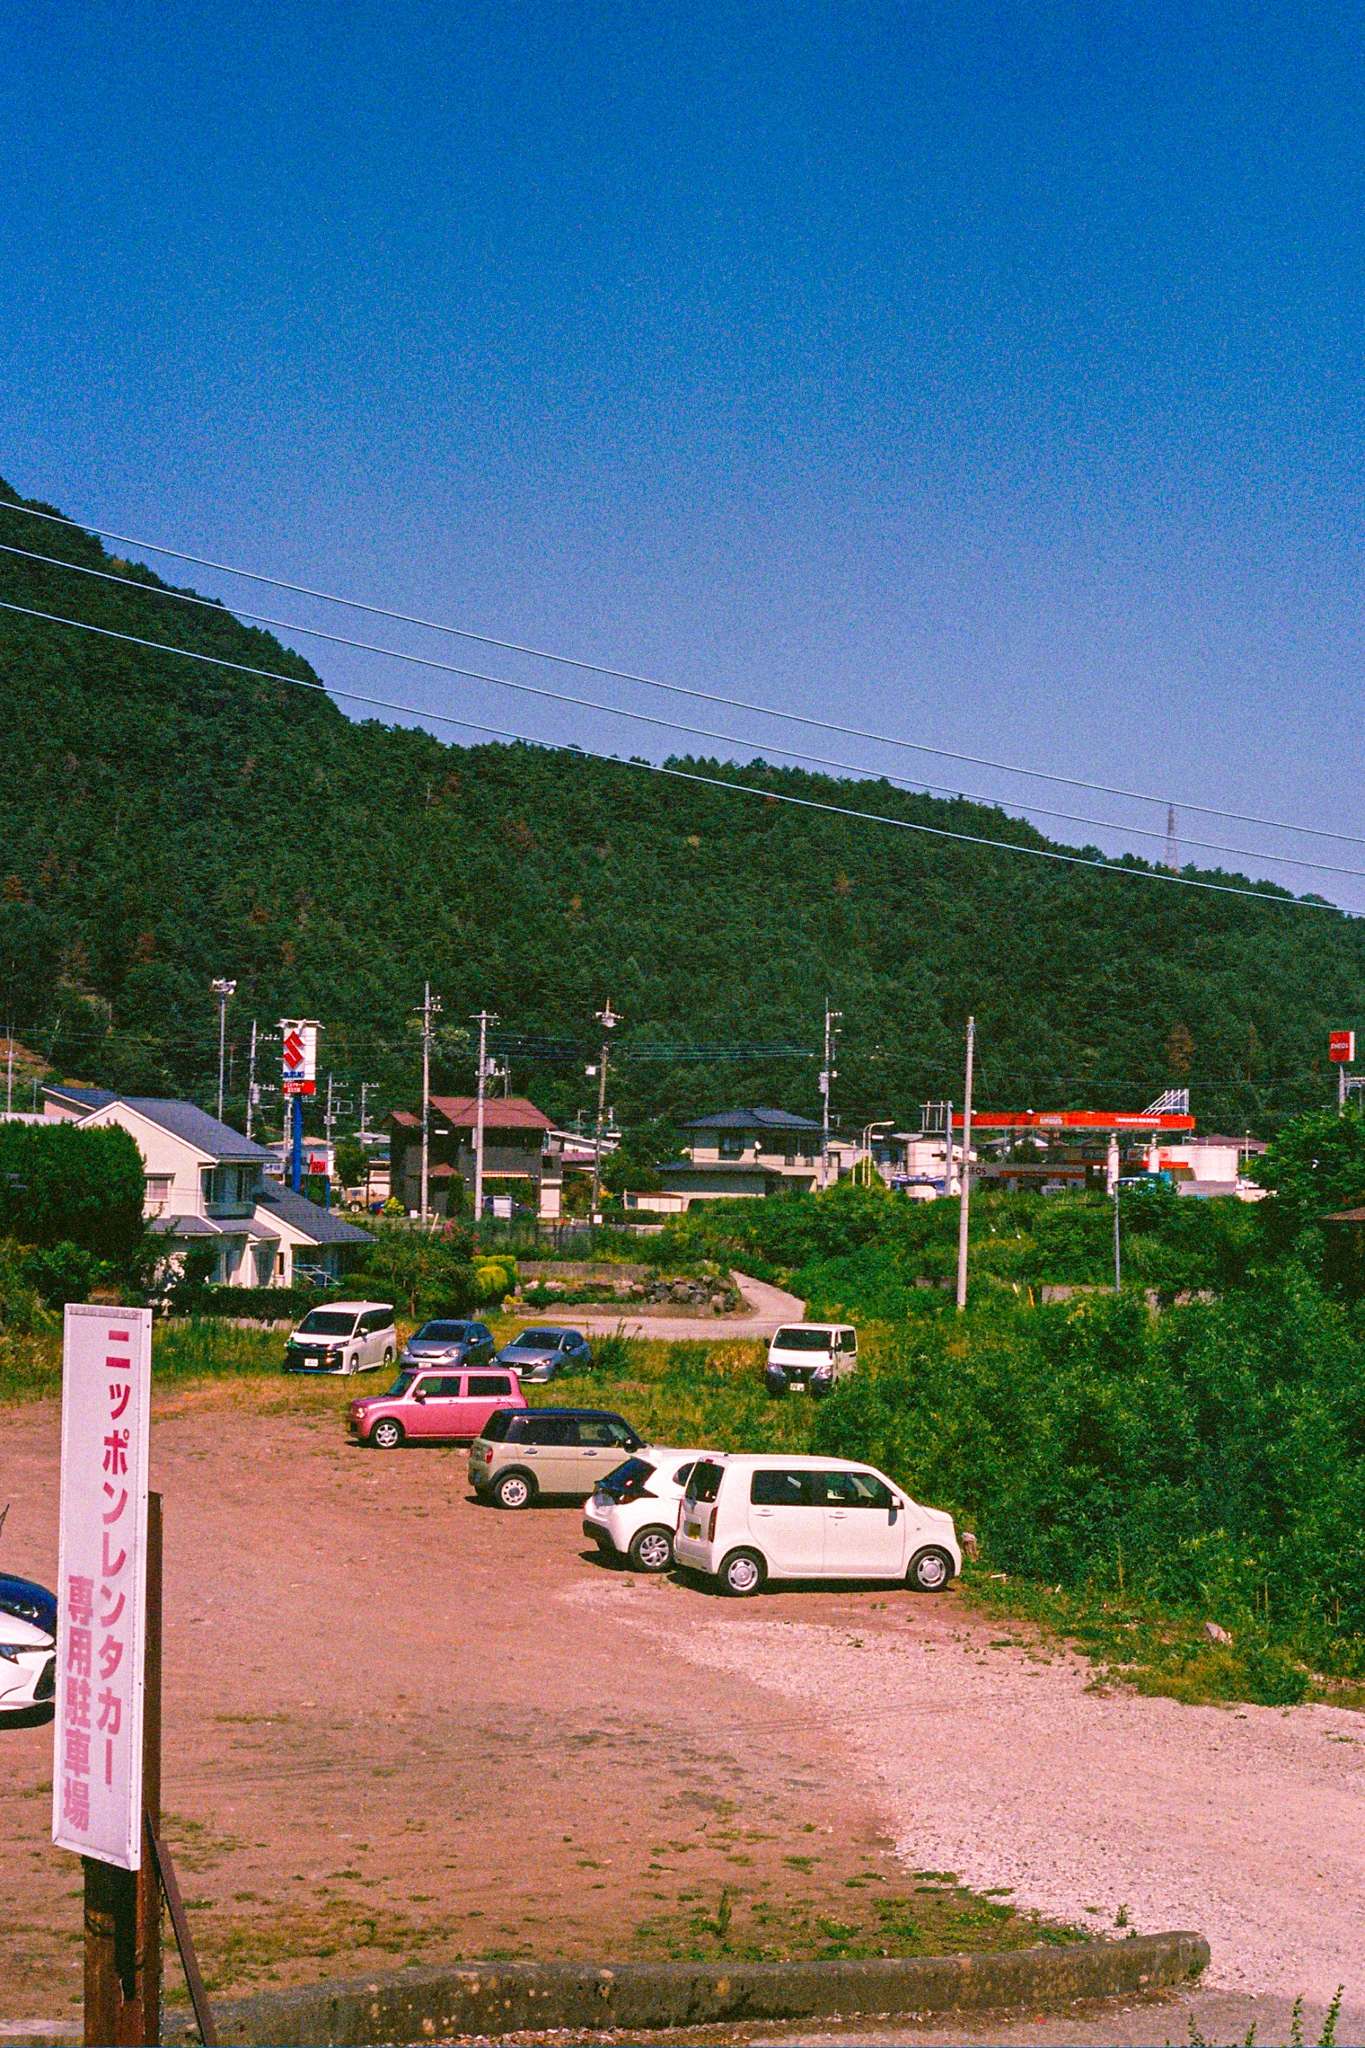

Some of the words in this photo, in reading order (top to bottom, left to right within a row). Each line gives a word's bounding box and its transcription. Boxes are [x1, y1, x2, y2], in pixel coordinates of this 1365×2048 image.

[1330, 1042, 1349, 1050] ENEOS
[97, 1330, 131, 1785] ニッポンレンタカー
[63, 1575, 95, 1832] 専用駐車場
